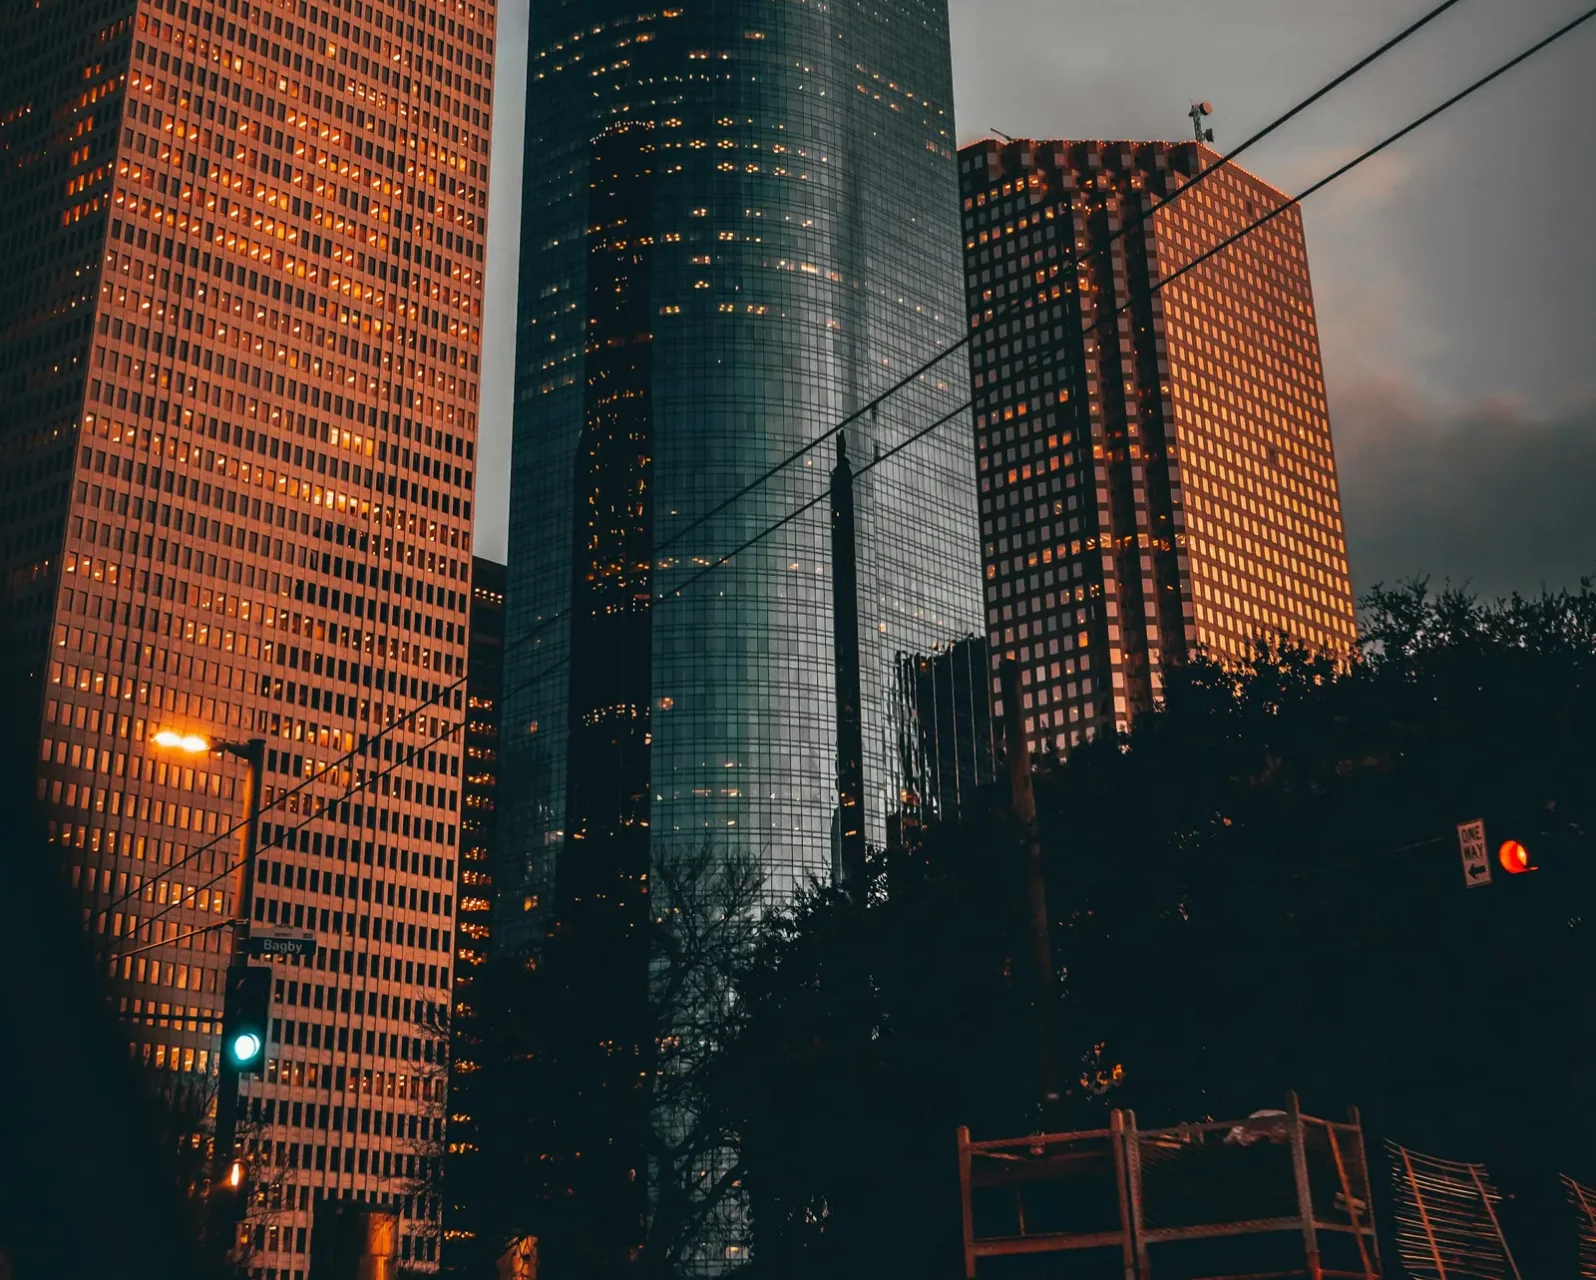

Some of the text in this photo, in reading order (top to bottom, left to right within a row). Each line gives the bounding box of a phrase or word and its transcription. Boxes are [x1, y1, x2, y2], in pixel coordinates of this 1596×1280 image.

[1461, 825, 1482, 843] ONE
[1464, 843, 1484, 861] WAY
[263, 938, 303, 953] Bagby
